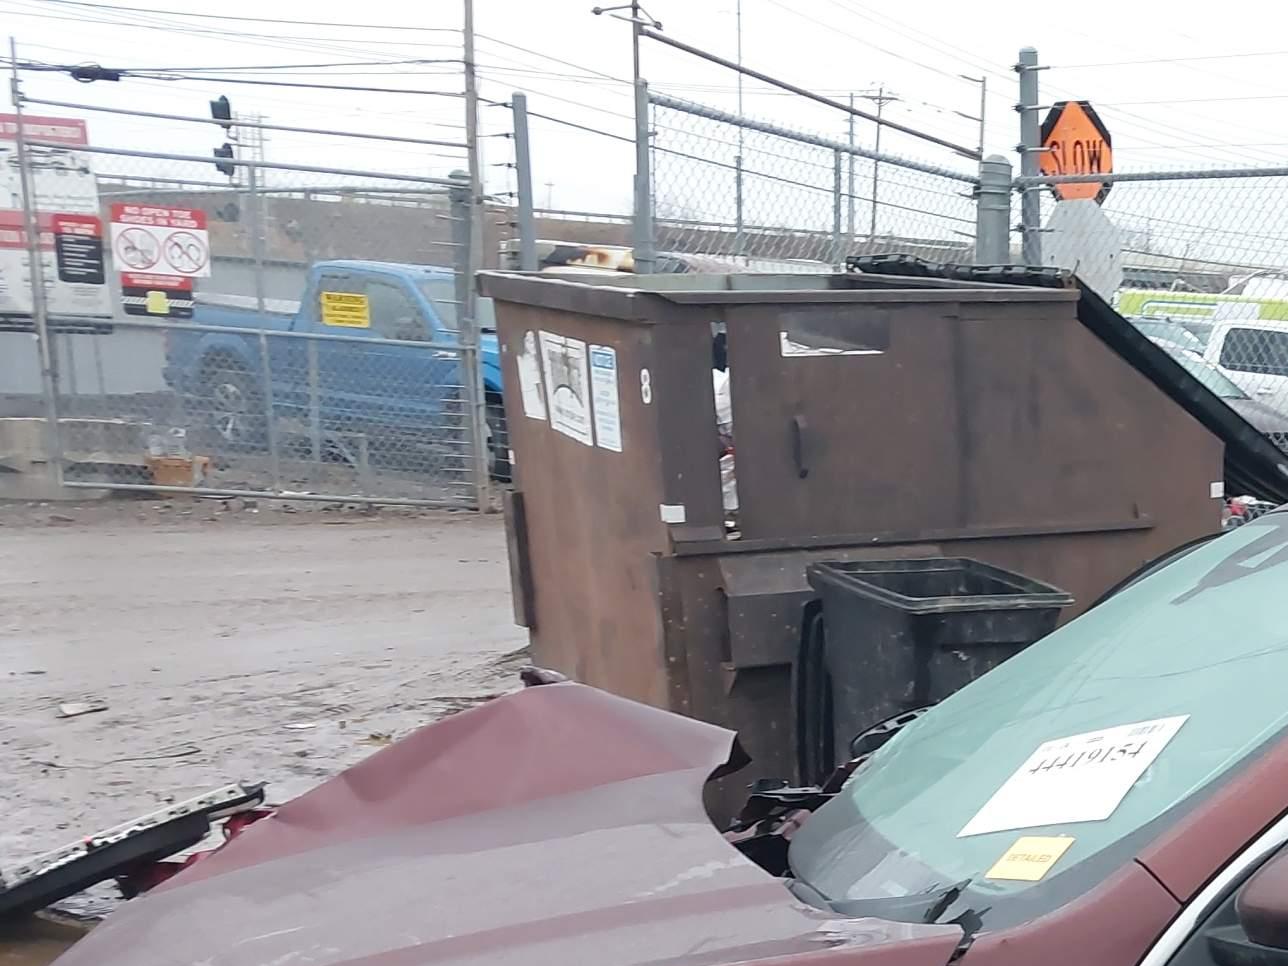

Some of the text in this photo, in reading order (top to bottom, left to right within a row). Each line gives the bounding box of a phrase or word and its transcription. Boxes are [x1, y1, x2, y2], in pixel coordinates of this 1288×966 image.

[1050, 139, 1103, 174] SLOW
[640, 368, 651, 404] 8
[1006, 853, 1053, 863] DETAILED
